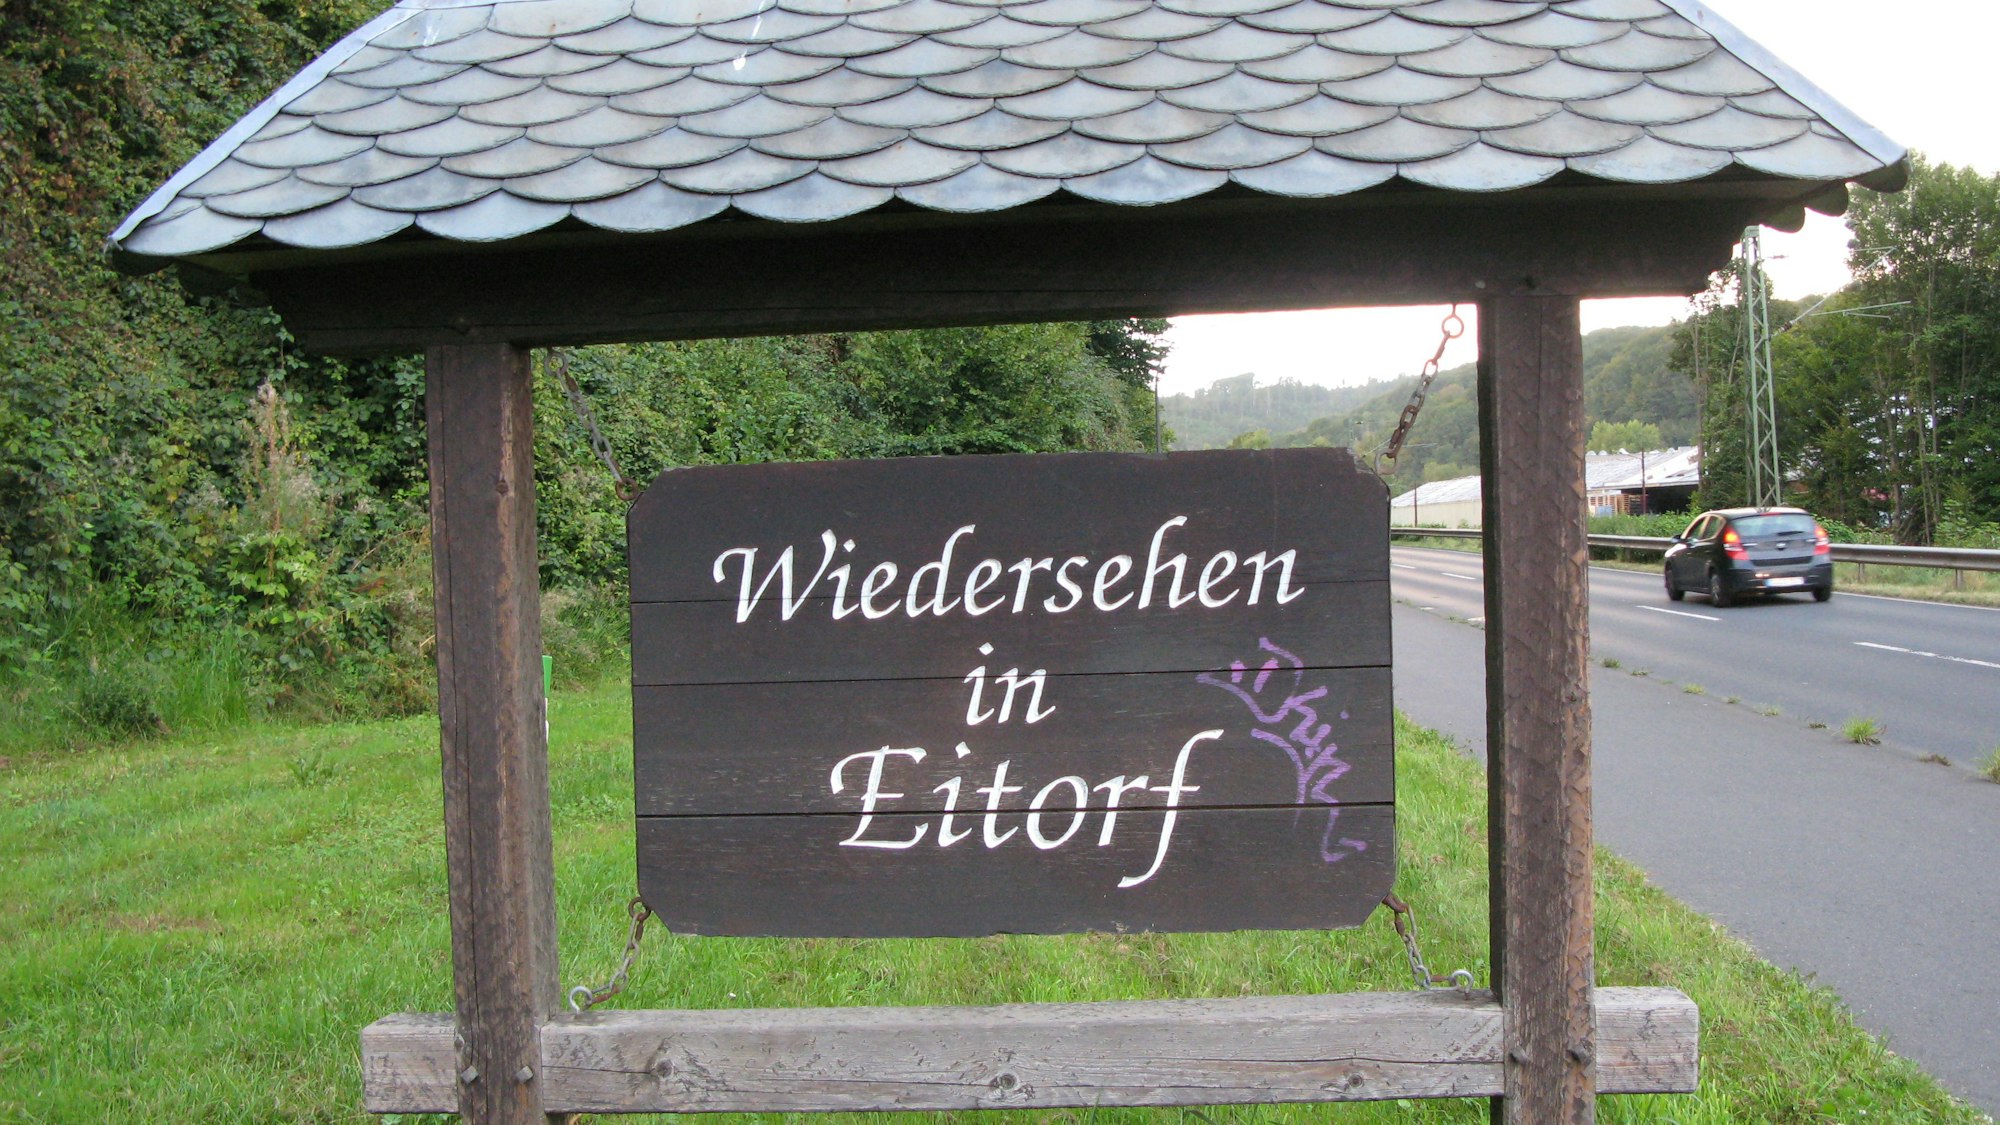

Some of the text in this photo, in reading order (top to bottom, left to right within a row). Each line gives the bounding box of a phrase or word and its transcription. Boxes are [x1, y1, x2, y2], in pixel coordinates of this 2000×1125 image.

[712, 515, 1305, 624] Wiedersehen
[962, 642, 1056, 726] in
[829, 728, 1225, 888] Eitorf
